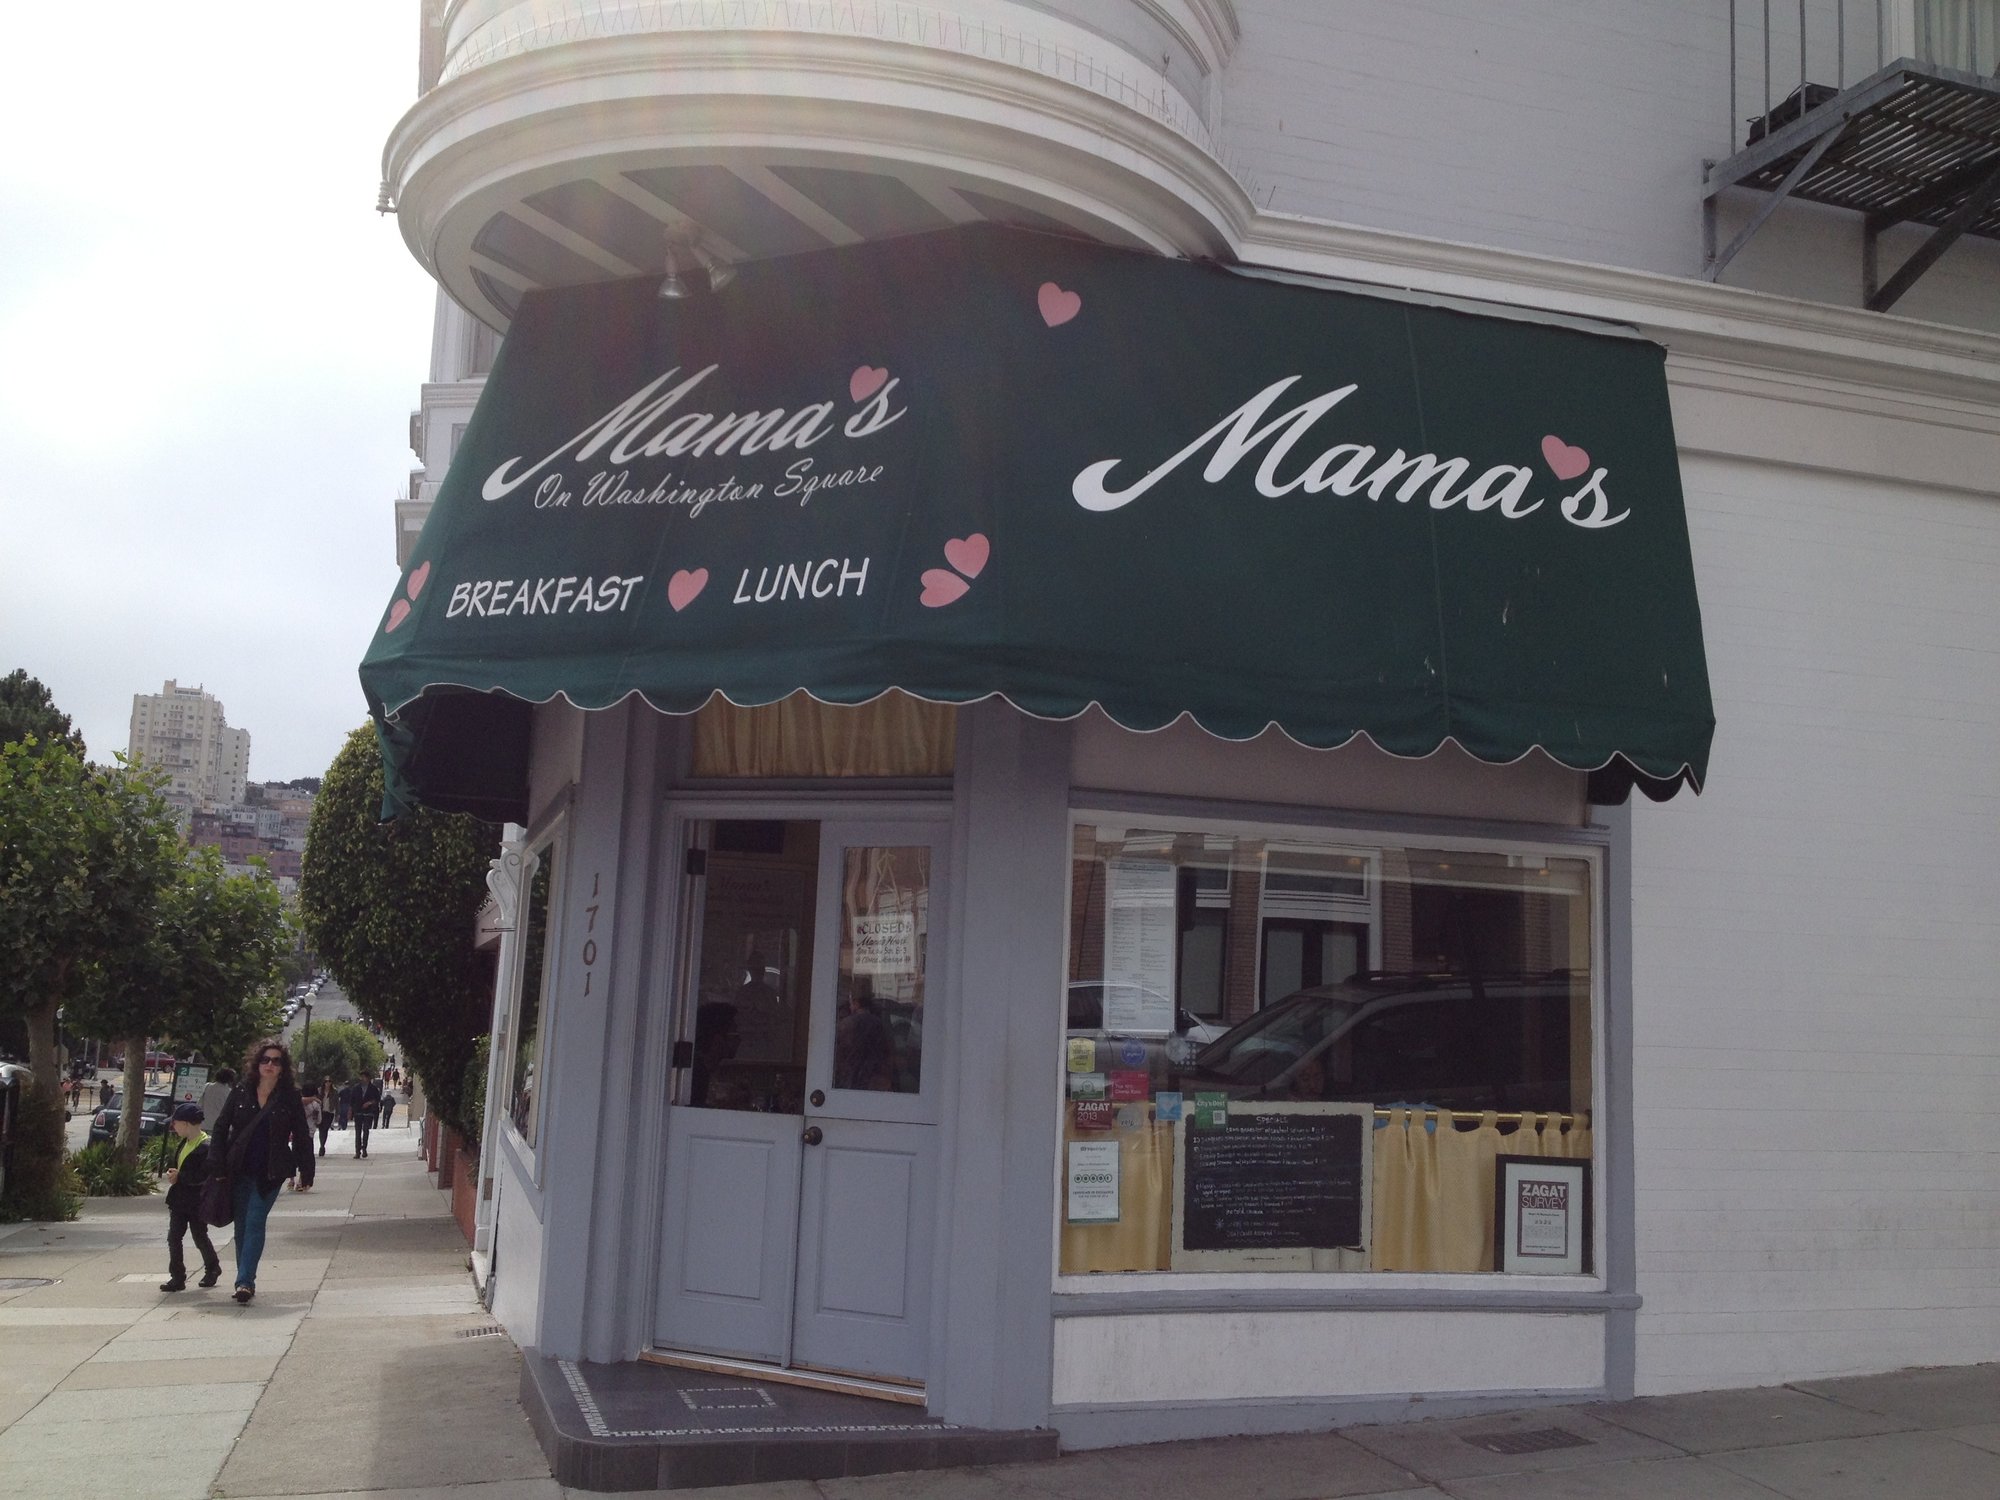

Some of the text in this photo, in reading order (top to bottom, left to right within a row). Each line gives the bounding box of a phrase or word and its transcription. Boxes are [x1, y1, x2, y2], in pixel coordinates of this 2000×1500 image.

[482, 363, 908, 501] Mama's
[1071, 374, 1632, 529] Mama's
[533, 457, 885, 519] On Washington Square
[732, 556, 870, 604] LUNCH
[445, 575, 644, 618] BREAKFAST
[862, 922, 905, 935] CLOSED
[180, 1067, 187, 1075] 2
[1077, 1102, 1110, 1111] ZAGAT
[1077, 1112, 1098, 1121] 2013
[1521, 1184, 1566, 1197] ZAGAT
[1521, 1196, 1566, 1209] SURVEY
